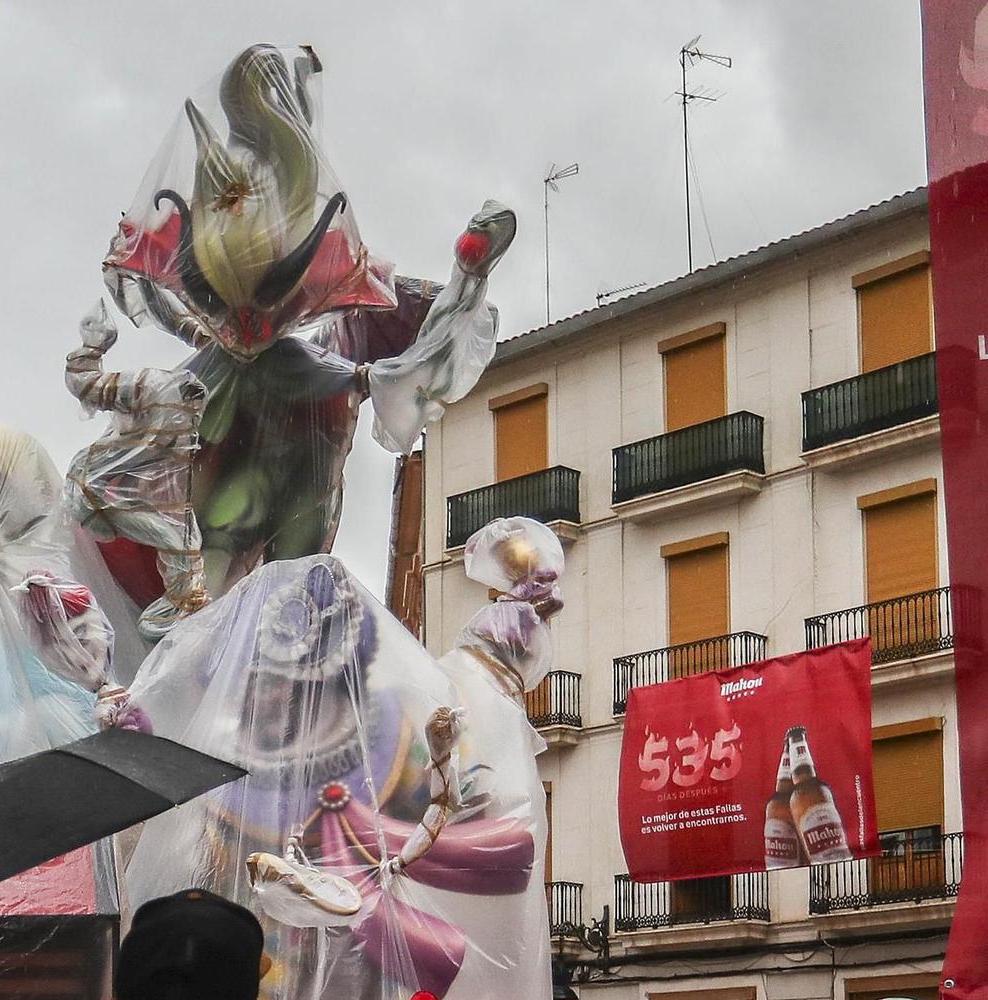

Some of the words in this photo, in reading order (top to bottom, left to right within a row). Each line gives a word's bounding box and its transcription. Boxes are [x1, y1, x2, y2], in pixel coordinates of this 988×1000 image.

[721, 677, 763, 696] Mahou
[638, 723, 742, 791] 535
[641, 815, 652, 824] Lo
[653, 812, 677, 823] mejor
[679, 810, 689, 819] de
[691, 807, 714, 817] estas
[715, 803, 742, 814] Fallas
[641, 826, 651, 834] es
[652, 823, 677, 833] volver
[679, 821, 685, 829] a
[685, 813, 747, 828] encontrarnos.
